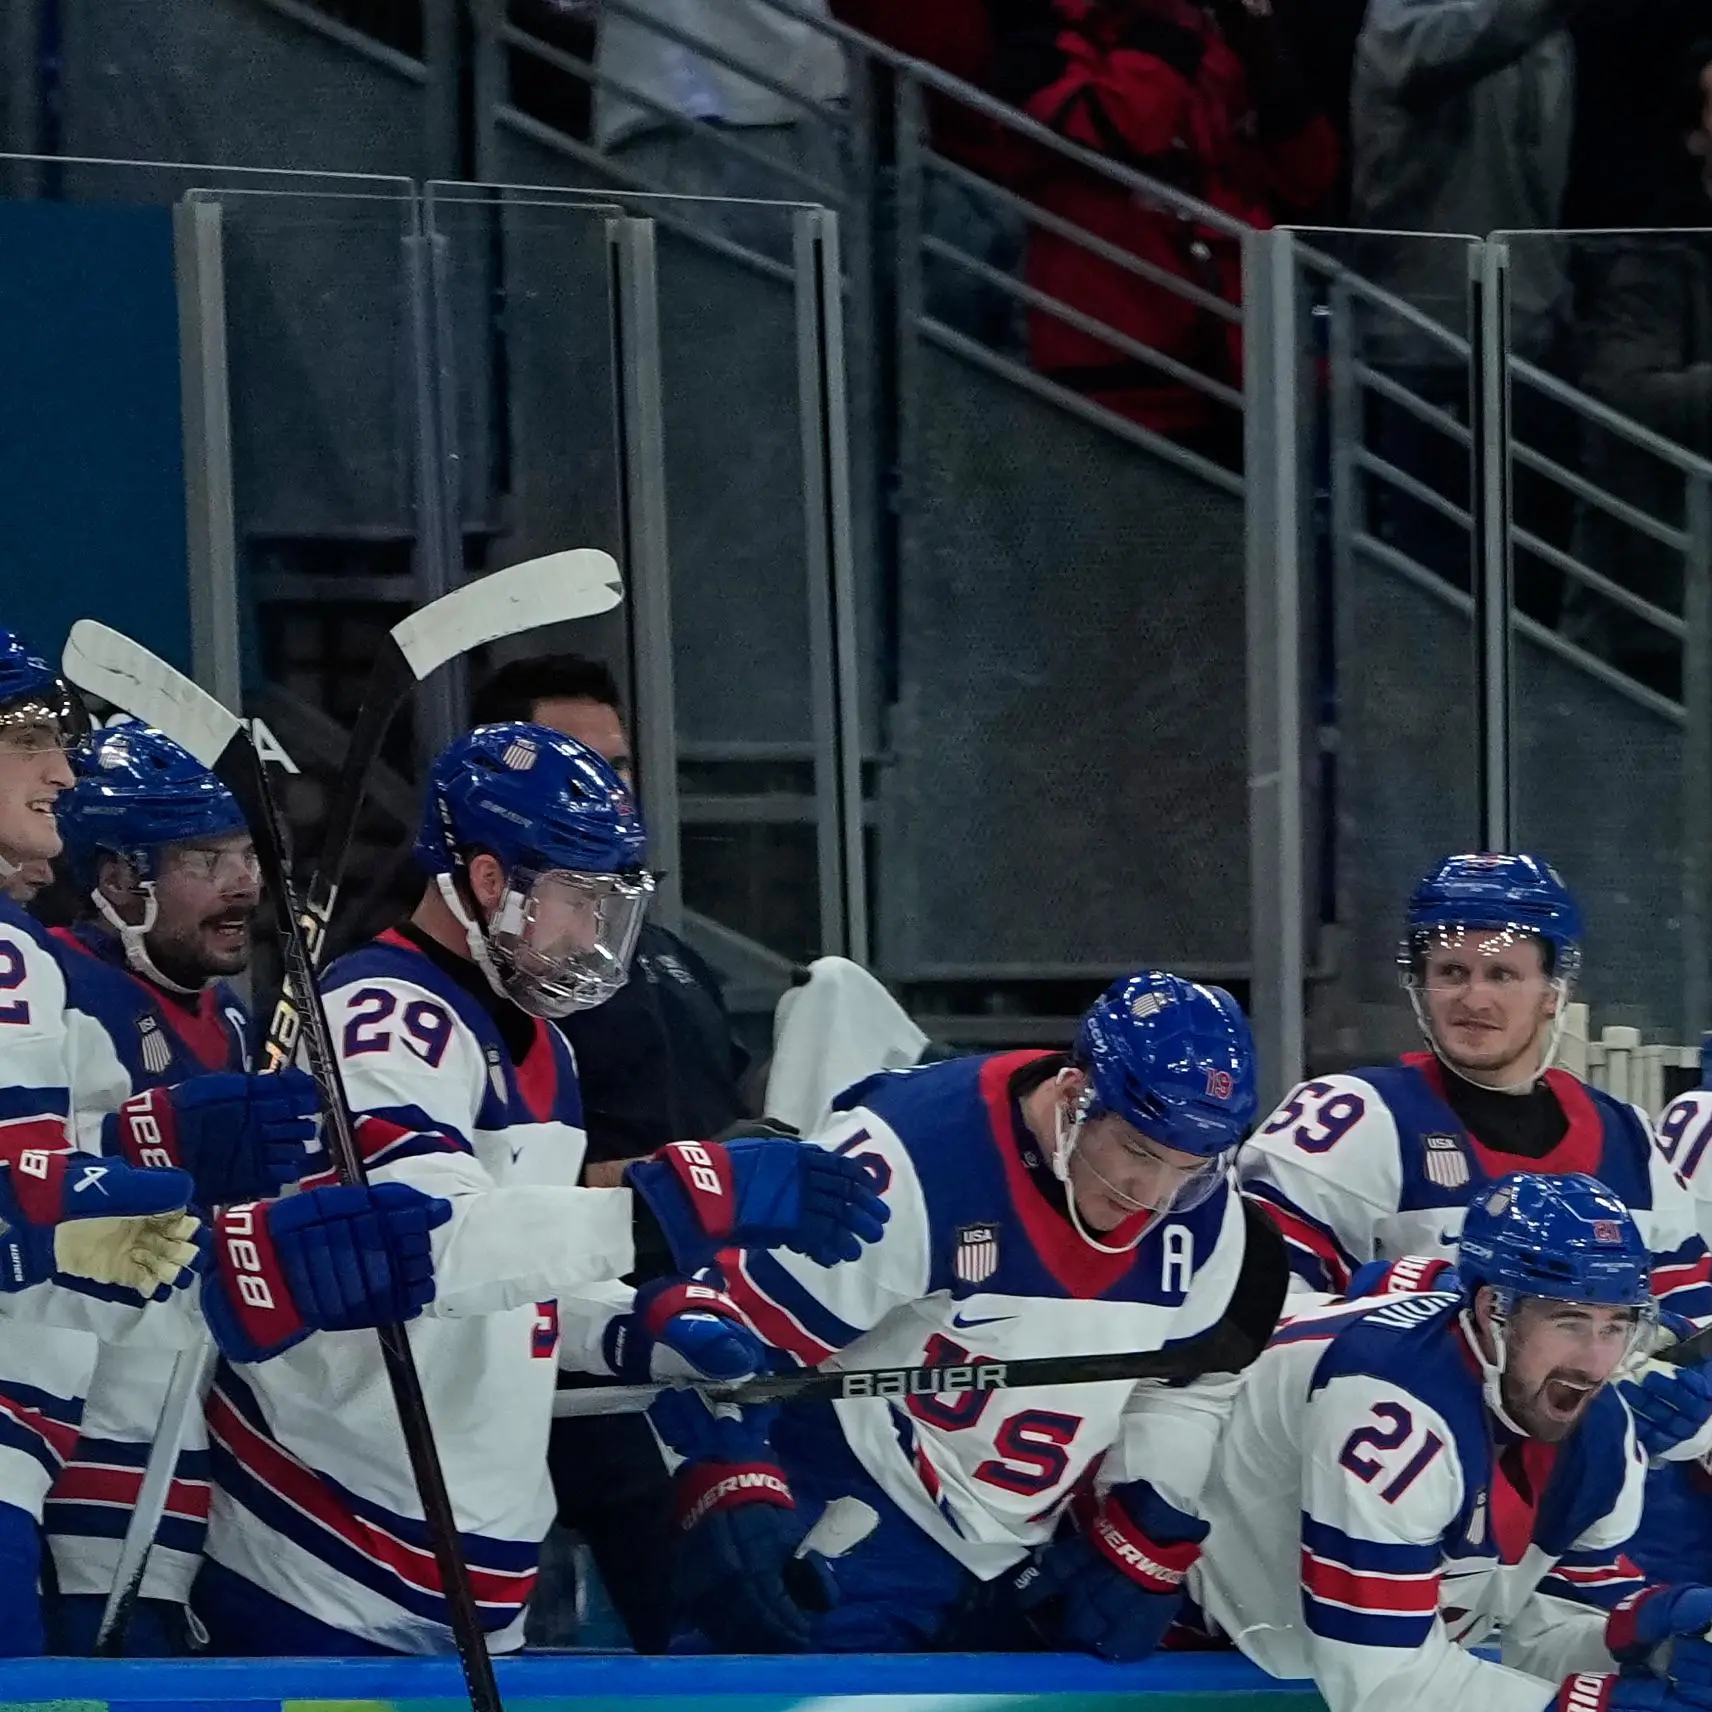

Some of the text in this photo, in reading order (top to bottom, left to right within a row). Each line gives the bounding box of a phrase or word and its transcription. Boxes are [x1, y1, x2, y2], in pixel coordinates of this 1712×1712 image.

[342, 986, 454, 1069] 29
[1262, 1081, 1366, 1154] 59
[224, 1202, 276, 1310] BAU
[962, 1228, 994, 1244] USA
[1160, 1223, 1195, 1293] A
[842, 1363, 1009, 1399] BAUER
[1337, 1401, 1445, 1505] 21
